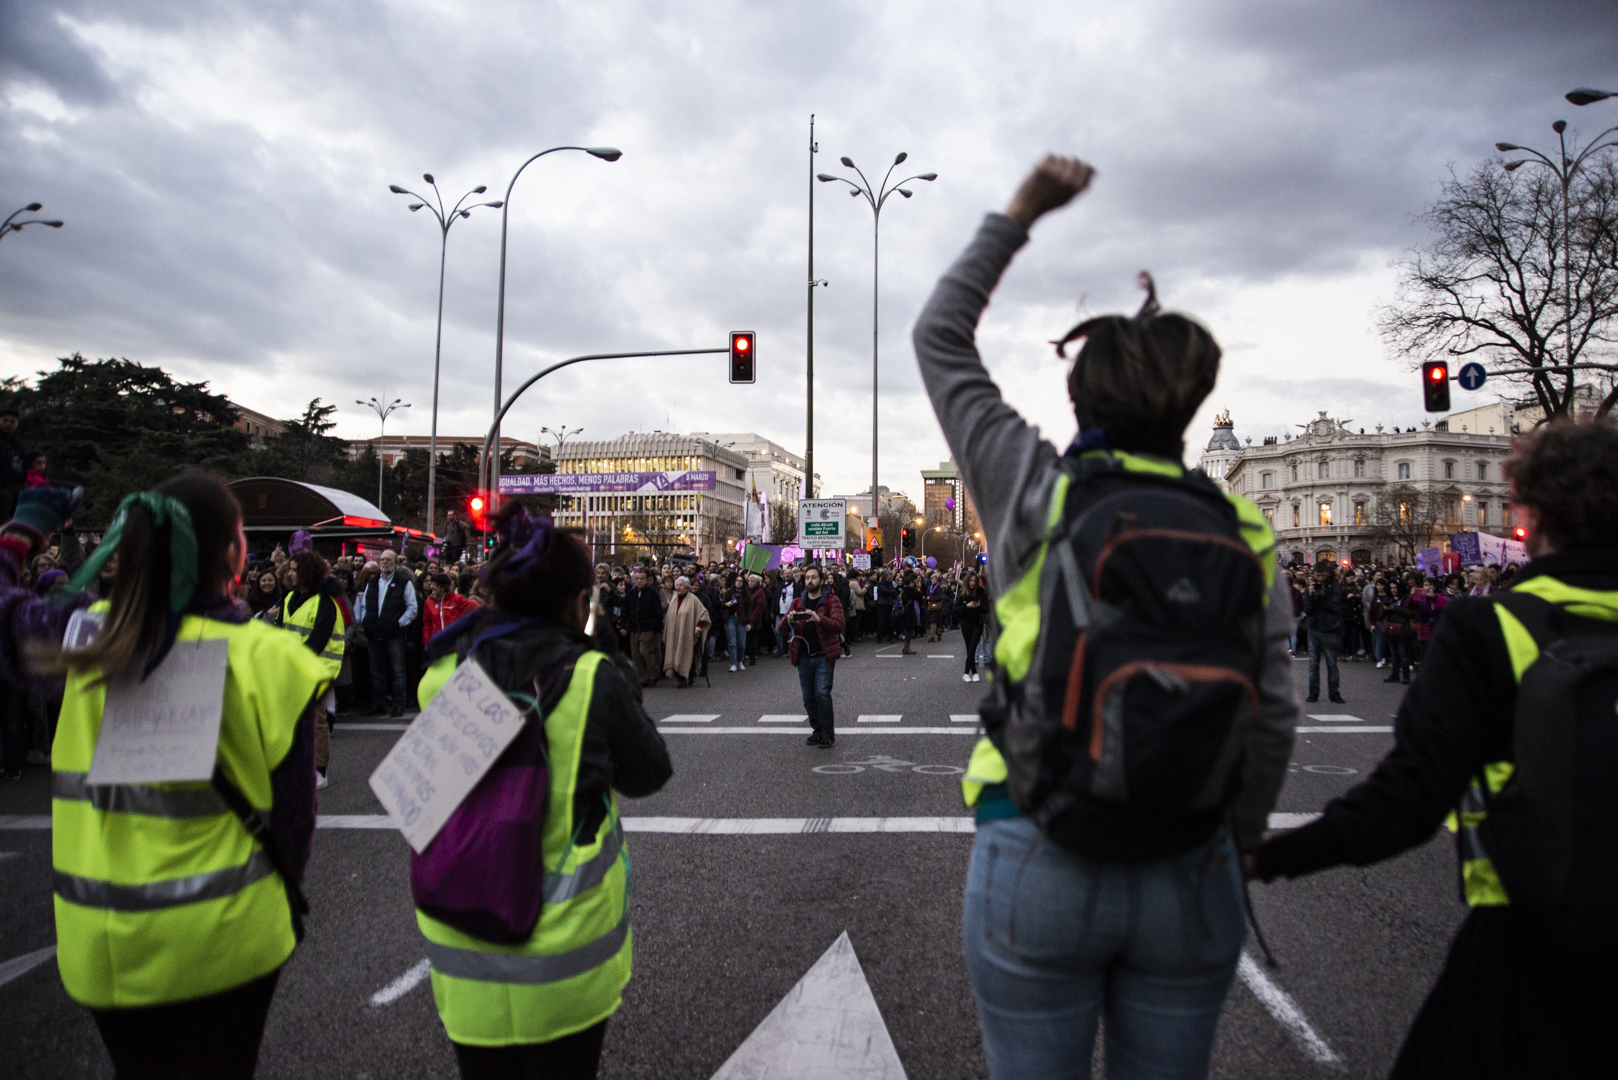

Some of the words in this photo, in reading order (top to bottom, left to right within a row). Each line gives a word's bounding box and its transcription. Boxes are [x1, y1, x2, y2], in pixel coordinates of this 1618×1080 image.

[499, 477, 532, 487] IGUALDAD.
[534, 474, 548, 486] MÁS
[549, 475, 577, 485] HECHOS.
[578, 474, 602, 485] MENOS
[603, 474, 638, 484] PALABRAS
[453, 666, 482, 701] POR
[476, 694, 510, 725] LOS
